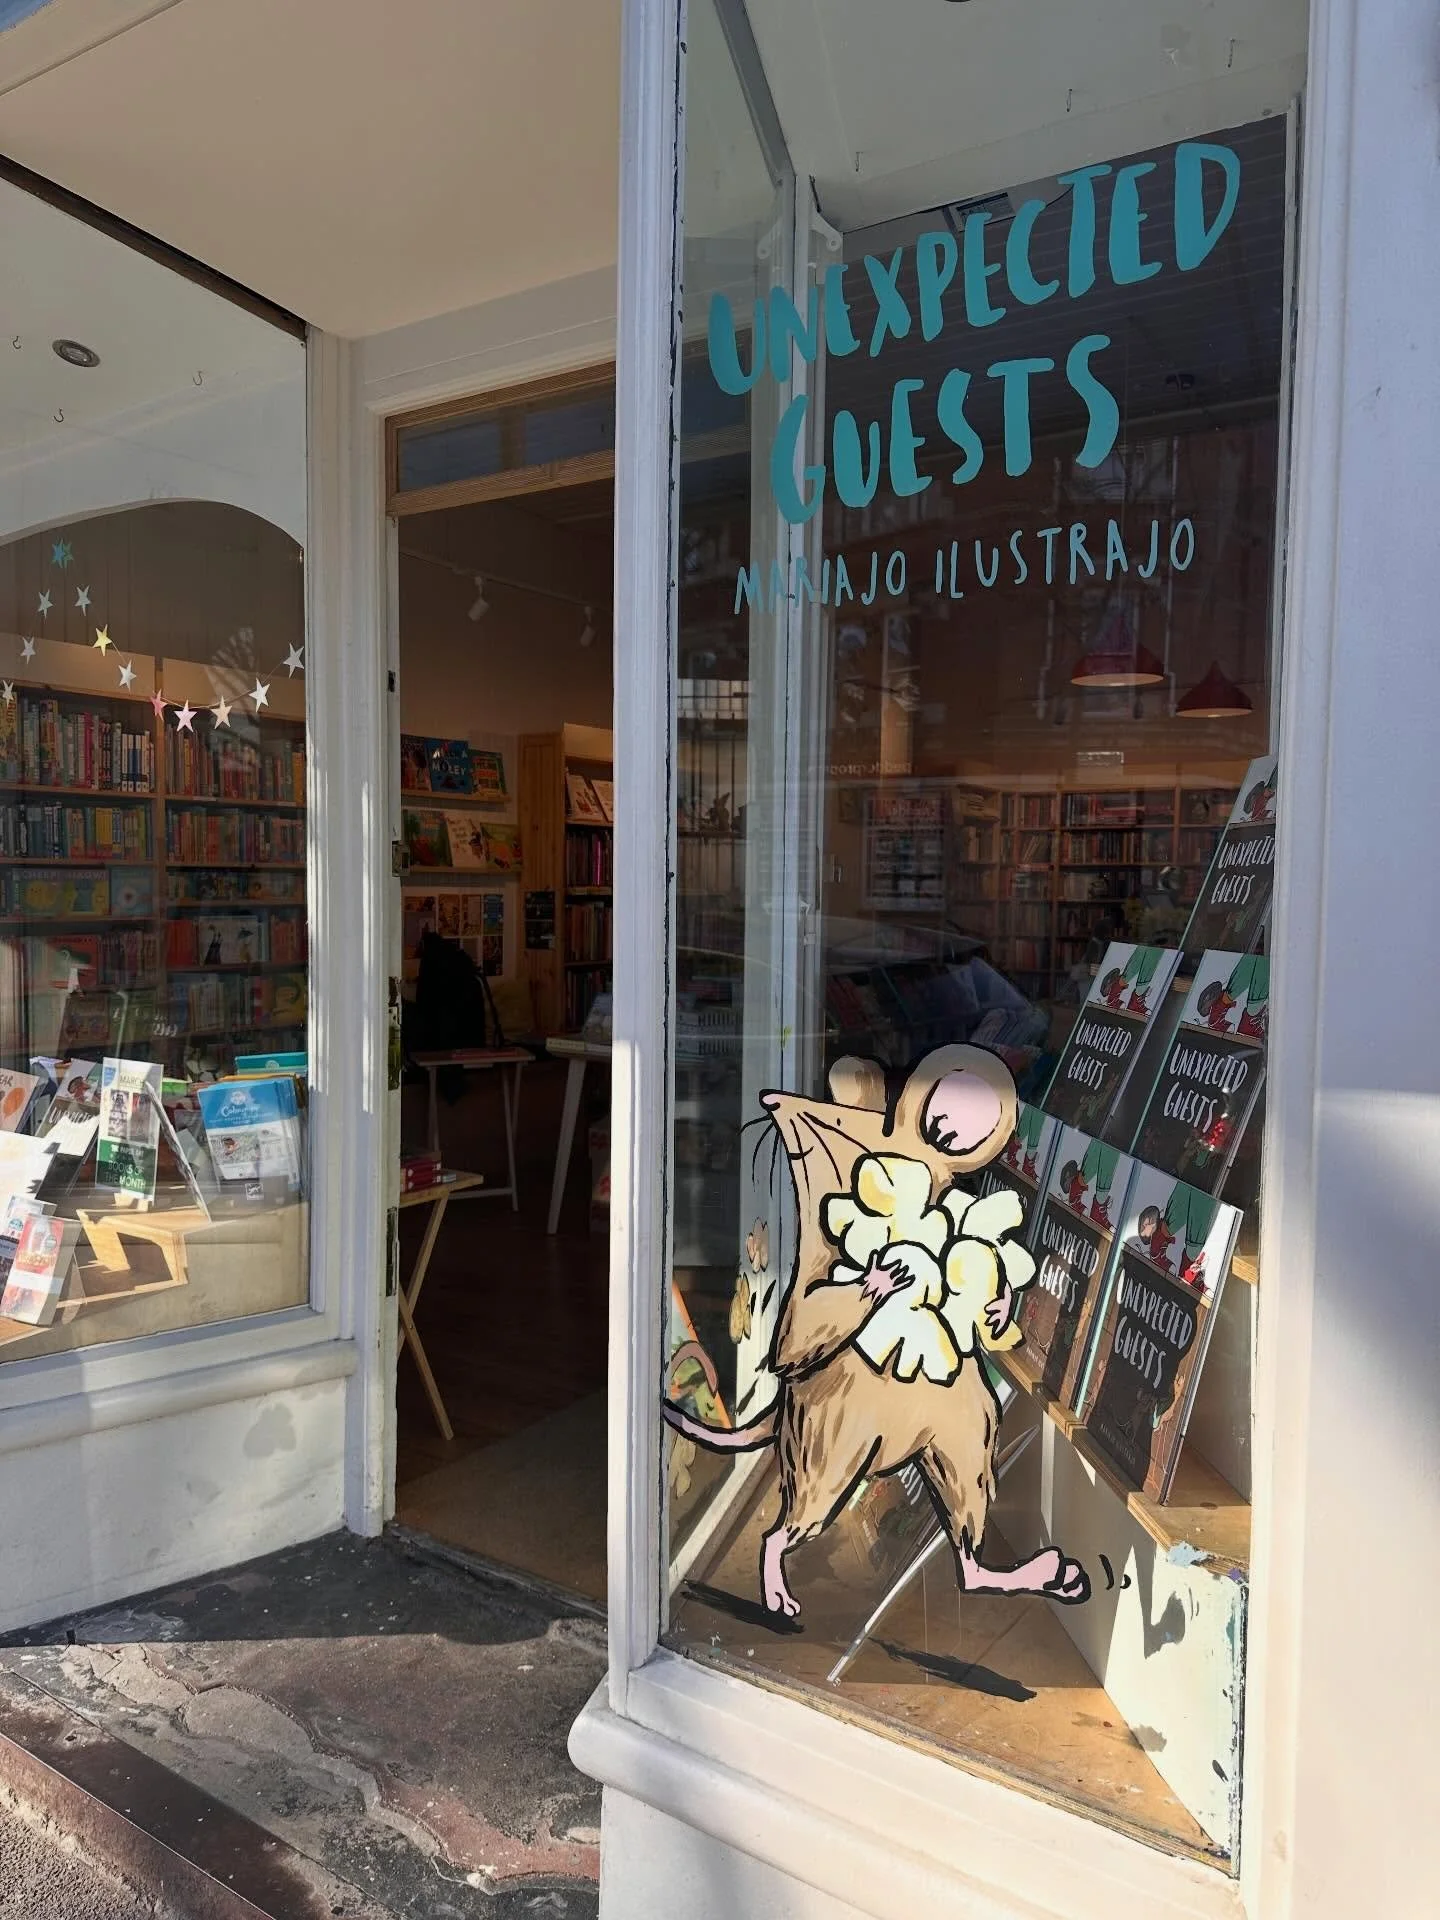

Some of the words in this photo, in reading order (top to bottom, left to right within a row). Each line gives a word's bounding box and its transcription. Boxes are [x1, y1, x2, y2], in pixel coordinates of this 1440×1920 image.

[708, 142, 1241, 395] UNEXPECTED
[771, 334, 1120, 524] GUESTS
[734, 550, 906, 615] MARIAJO
[935, 518, 1195, 599] ILUSTRAJO
[1211, 873, 1255, 905] GUESTS
[1075, 1019, 1132, 1058] UNEXPECTED
[1068, 1050, 1108, 1091] GUESTS
[1170, 1043, 1248, 1094] UNEXPECTED
[1164, 1082, 1218, 1133] GUESTS
[119, 1175, 147, 1190] MONTH
[1042, 1214, 1100, 1278] UNEXPECTED
[1039, 1253, 1079, 1312] GUESTS
[1116, 1267, 1192, 1350] UNEXPECTED
[1114, 1315, 1166, 1389] GUESTS
